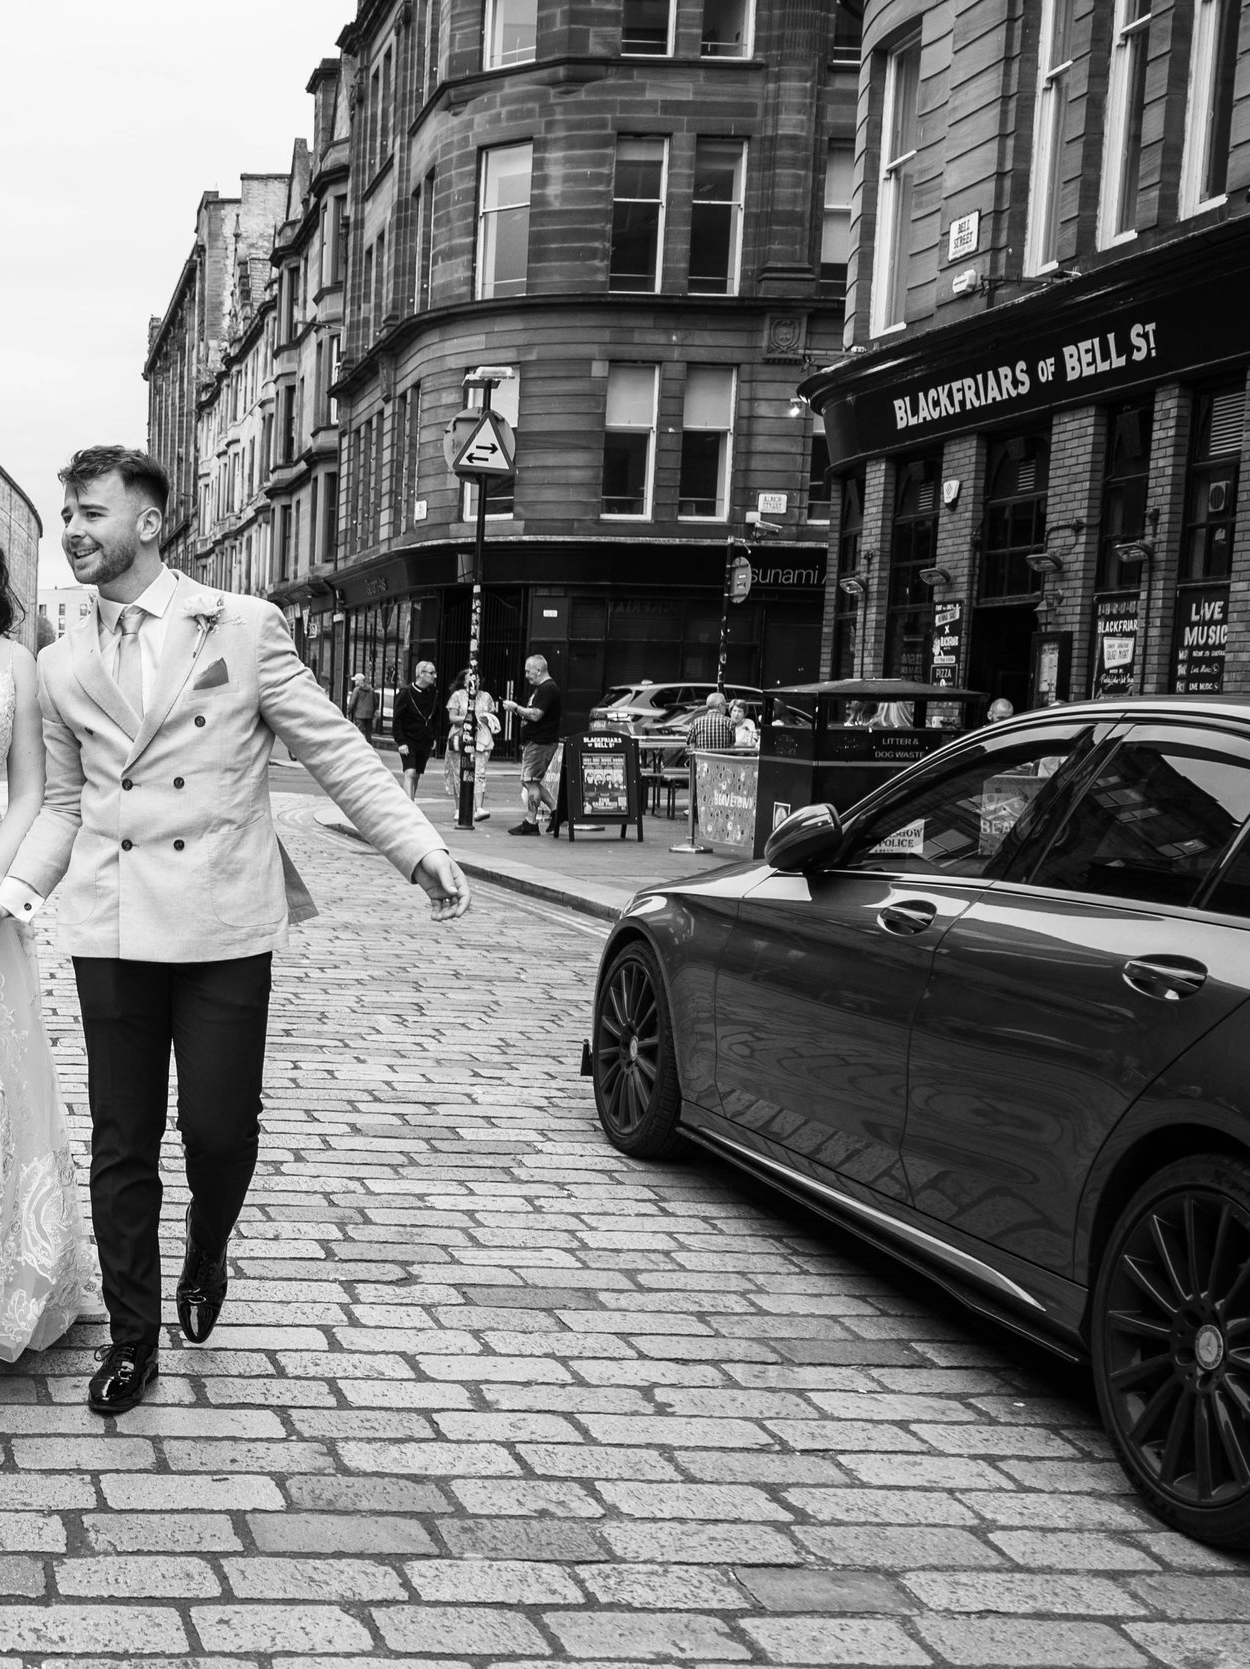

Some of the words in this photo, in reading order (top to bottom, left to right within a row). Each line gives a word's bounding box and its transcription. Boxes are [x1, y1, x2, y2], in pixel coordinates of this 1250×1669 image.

[893, 360, 1031, 430] BLACKFRIARS
[1037, 357, 1055, 383] OF
[1062, 332, 1127, 381] BELL
[750, 565, 820, 585] sunami
[1191, 601, 1224, 622] LIVE
[1097, 619, 1139, 633] BLACKFRIAR
[1184, 625, 1228, 647] MUSIC
[936, 668, 952, 678] PIZZA
[882, 737, 912, 745] LITTER
[878, 839, 914, 848] POLICE
